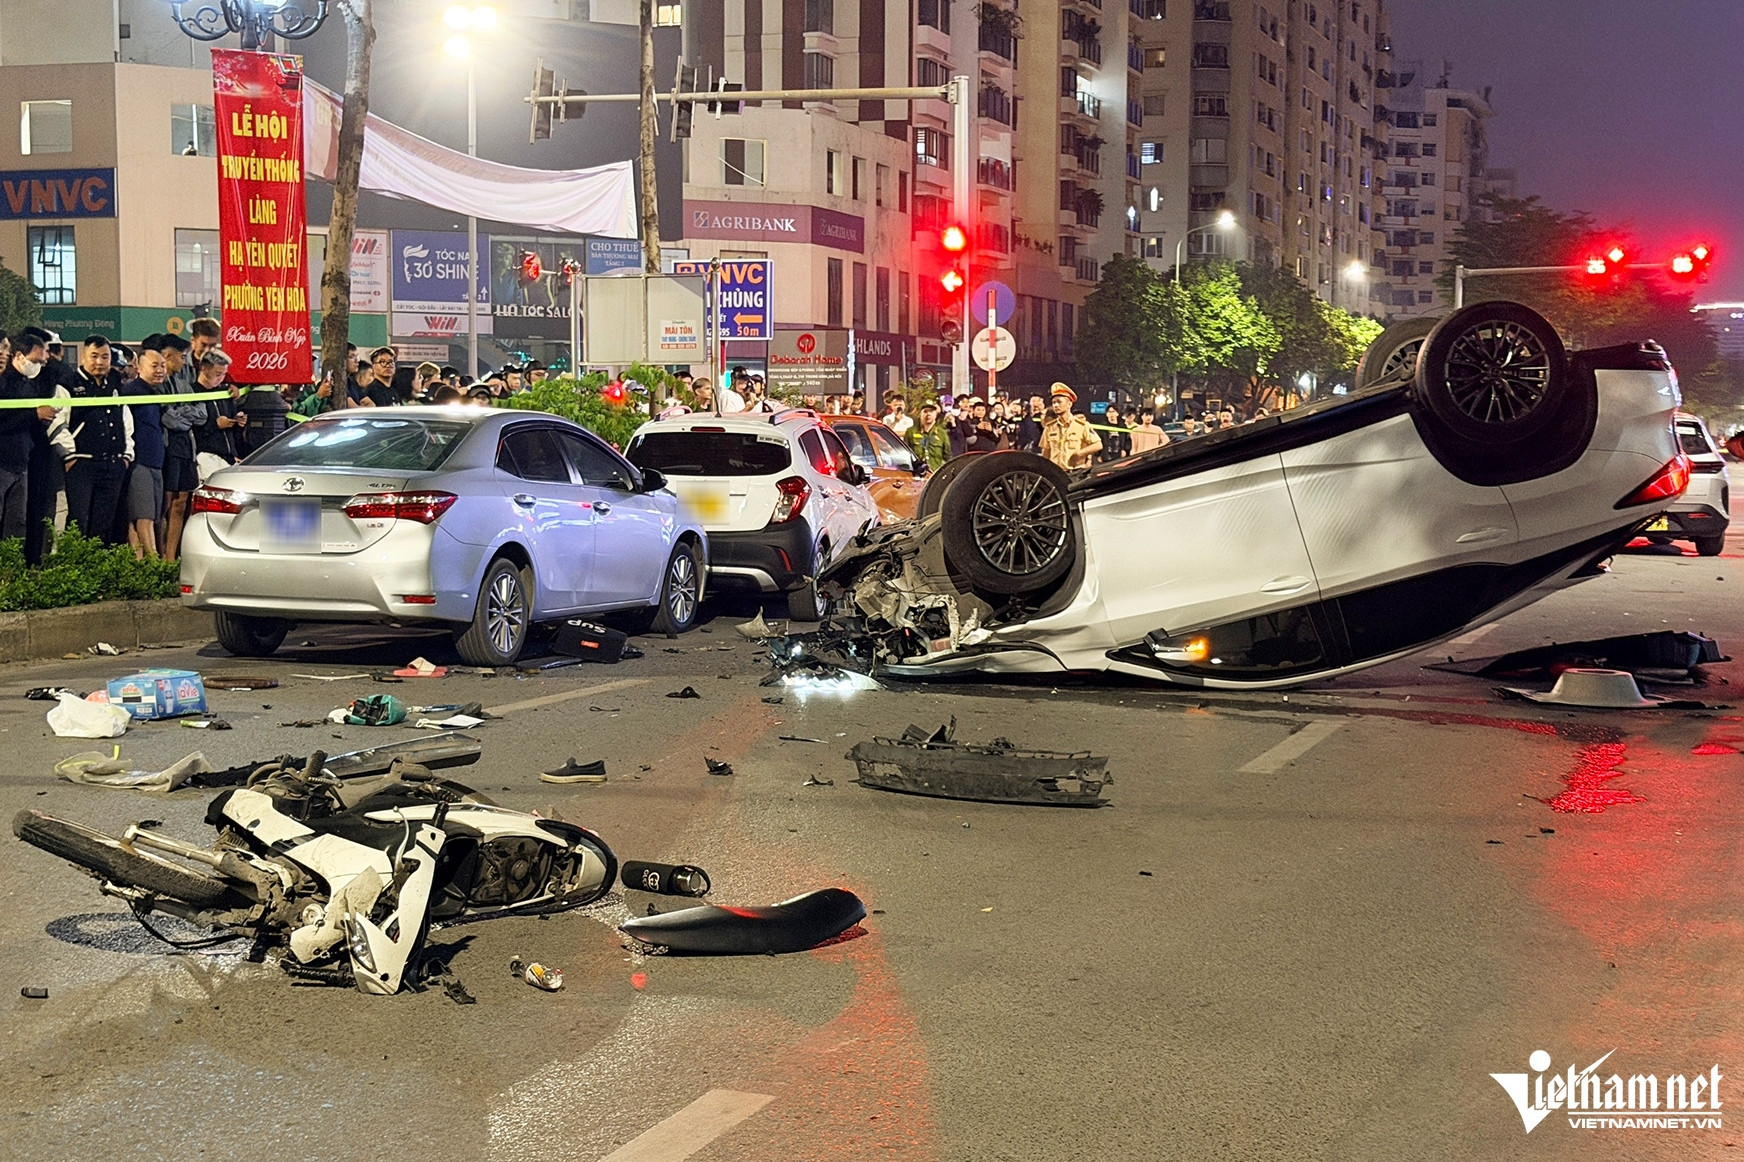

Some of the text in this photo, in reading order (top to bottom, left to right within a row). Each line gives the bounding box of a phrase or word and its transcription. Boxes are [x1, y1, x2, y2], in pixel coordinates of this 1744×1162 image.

[232, 104, 253, 137] LỄ
[255, 110, 288, 143] HỘI
[265, 151, 300, 183] THỐNG
[3, 176, 107, 214] VNVC
[249, 193, 277, 225] LÀNG
[711, 216, 797, 232] AGRIBANK
[229, 235, 298, 272] HẠ YÊN QUYẾT
[435, 249, 456, 260] TÓC
[590, 241, 639, 253] CHO THUÊ
[224, 280, 306, 312] PHƯỜNG YÊN HÒA
[737, 326, 759, 336] 50m
[856, 338, 891, 356] HLANDS
[246, 351, 289, 370] 2026
